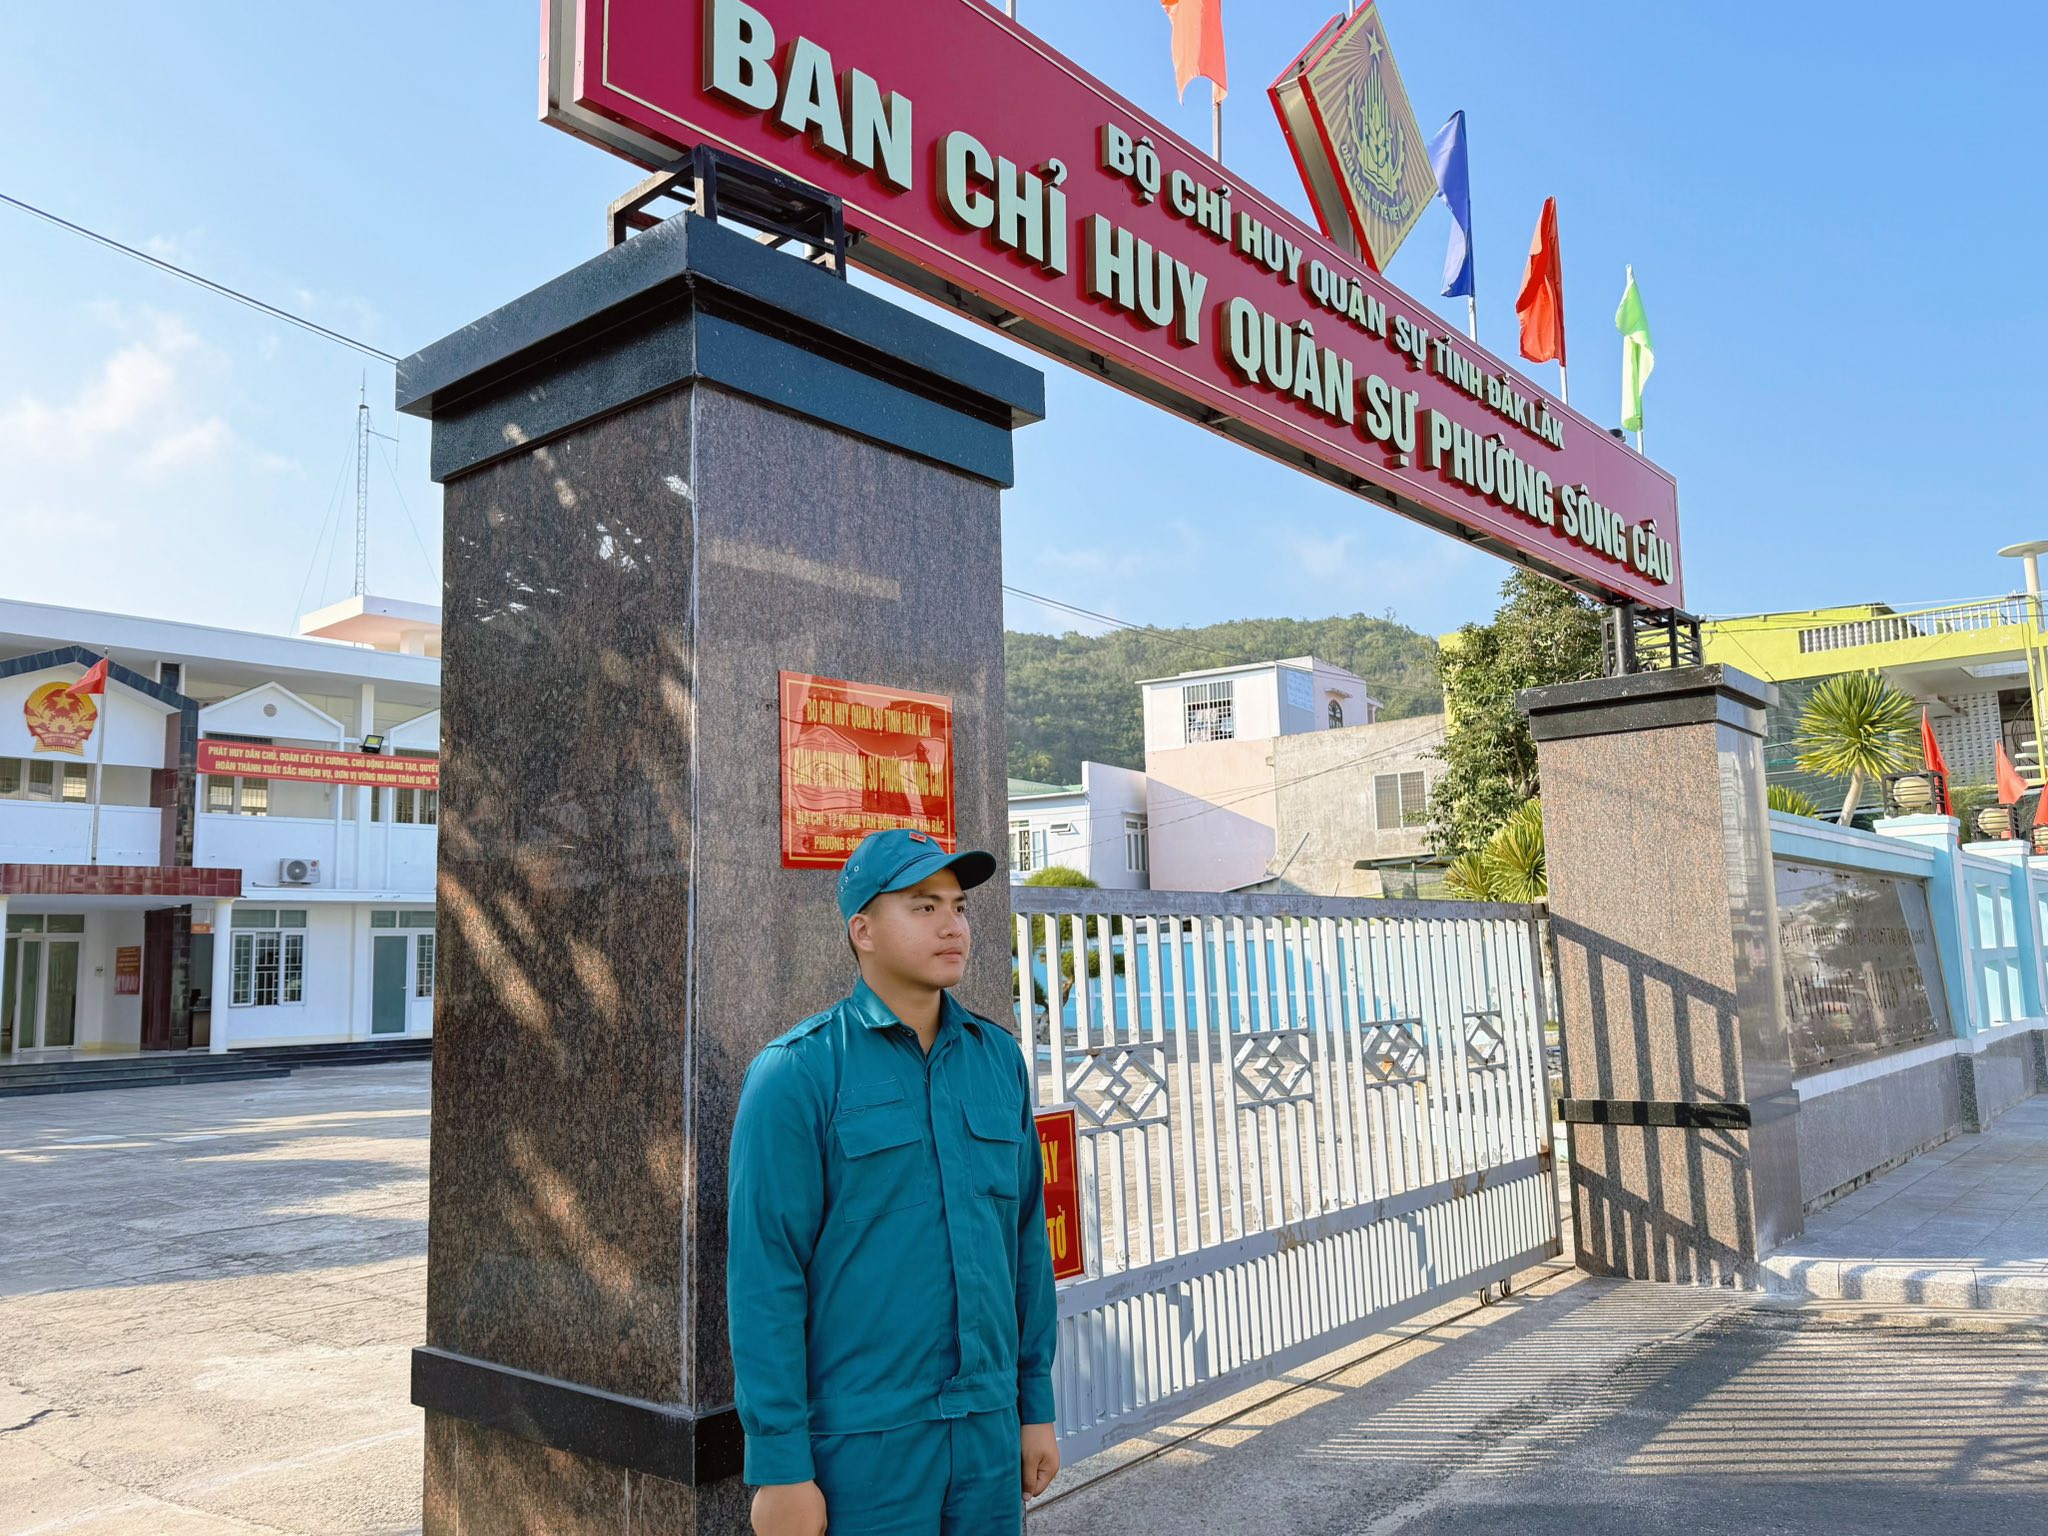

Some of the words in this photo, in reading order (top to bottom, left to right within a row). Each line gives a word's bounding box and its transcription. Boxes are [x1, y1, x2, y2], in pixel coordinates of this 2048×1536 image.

[705, 0, 912, 192] BAN
[938, 131, 1068, 277] CHỈ
[1089, 213, 1208, 345] HUY
[1223, 296, 1353, 426] QUÂN
[1367, 374, 1419, 466] SỰ
[1425, 408, 1554, 526] PHƯỜNG
[1556, 484, 1627, 563] SÔNG
[1628, 519, 1673, 585] CẦU
[1103, 122, 1161, 203] BỘ
[1168, 169, 1232, 242] CHỈ
[1236, 211, 1303, 284] HUY
[1306, 259, 1387, 339] QUÂN
[1392, 314, 1429, 370] SỰ
[1431, 334, 1483, 400] TỈNH
[208, 745, 228, 756] PHÁT
[229, 747, 245, 758] HUY
[834, 701, 849, 726] HUY
